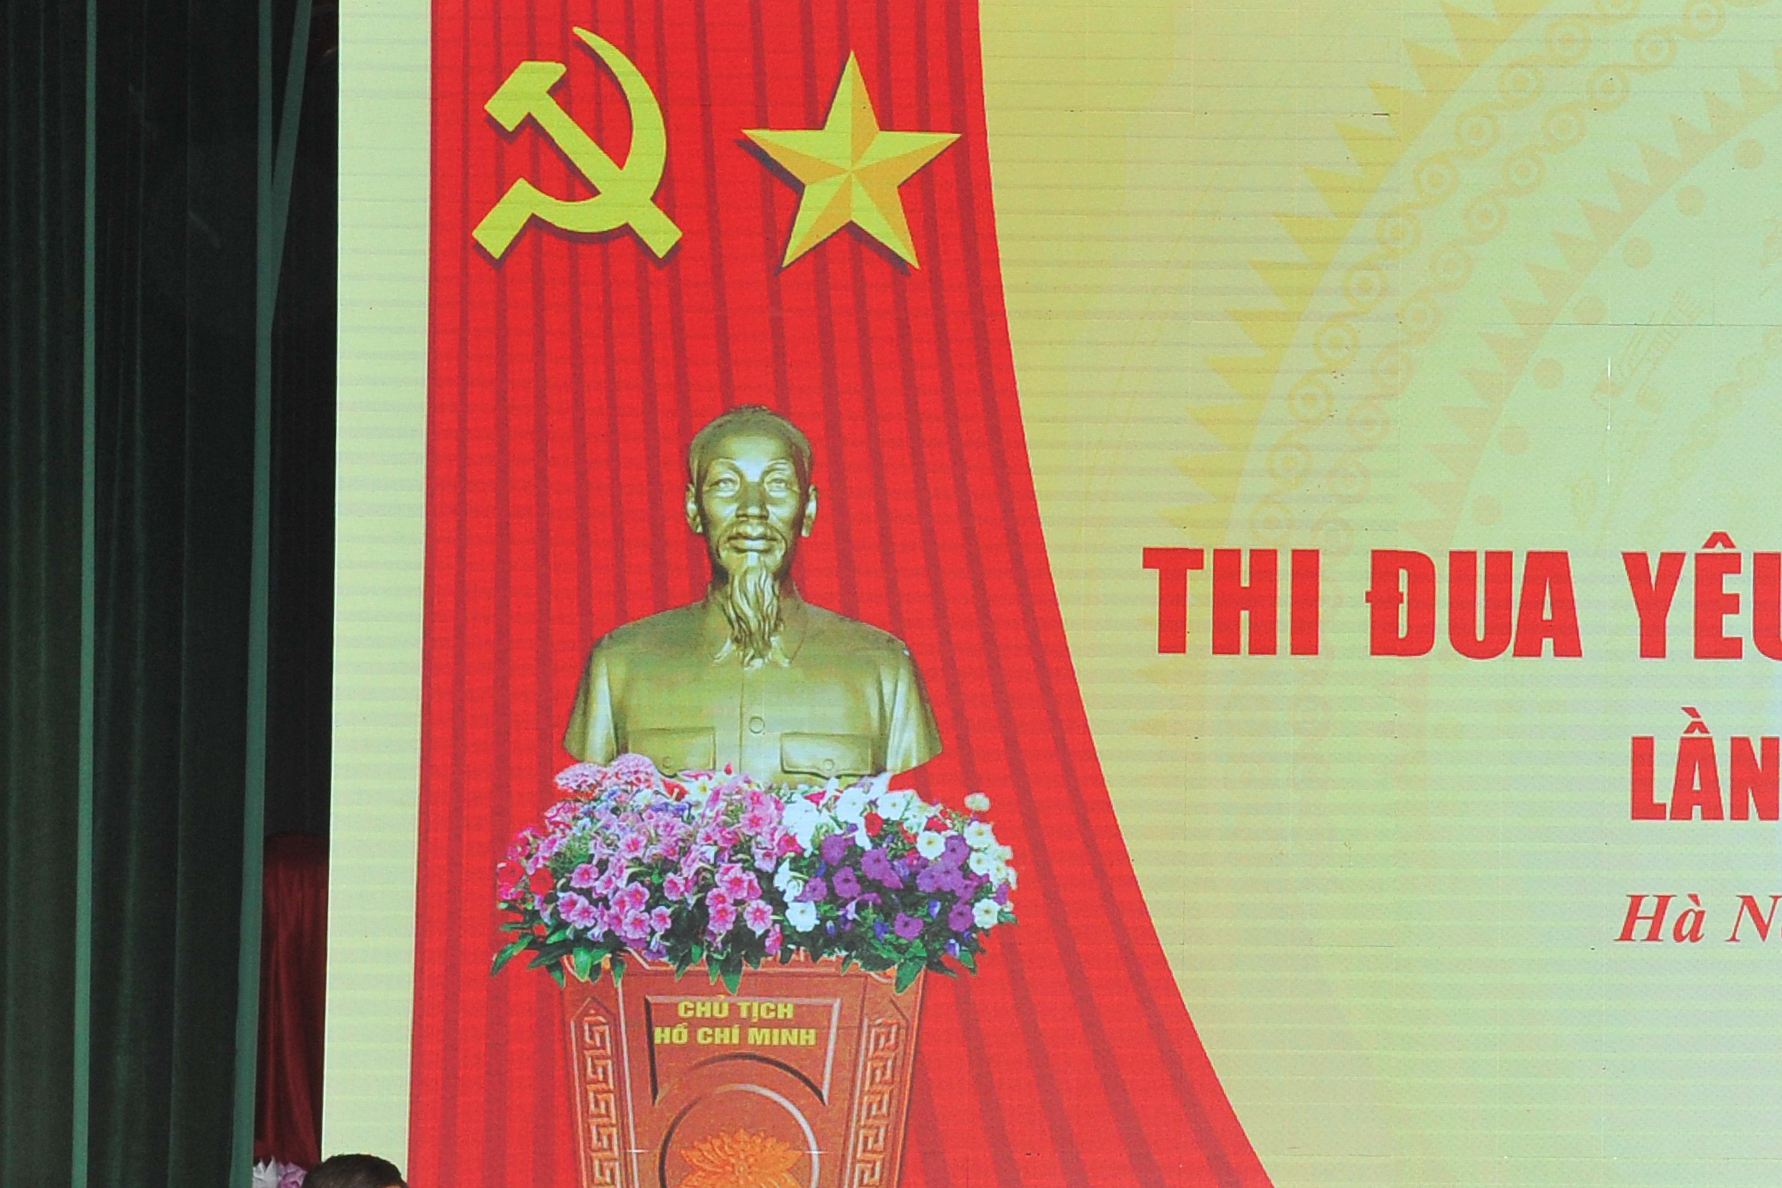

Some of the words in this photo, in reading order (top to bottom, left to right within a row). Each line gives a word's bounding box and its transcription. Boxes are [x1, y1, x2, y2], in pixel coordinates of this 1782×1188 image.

[1142, 546, 1321, 656] THI
[1365, 548, 1583, 660] ĐUA
[1631, 707, 1781, 821] LẦN
[1614, 894, 1706, 944] Hà
[678, 994, 730, 1019] CHỦ
[737, 1001, 795, 1023] TỊCH
[697, 1024, 740, 1045] CHÍ
[748, 1027, 817, 1046] MINH
